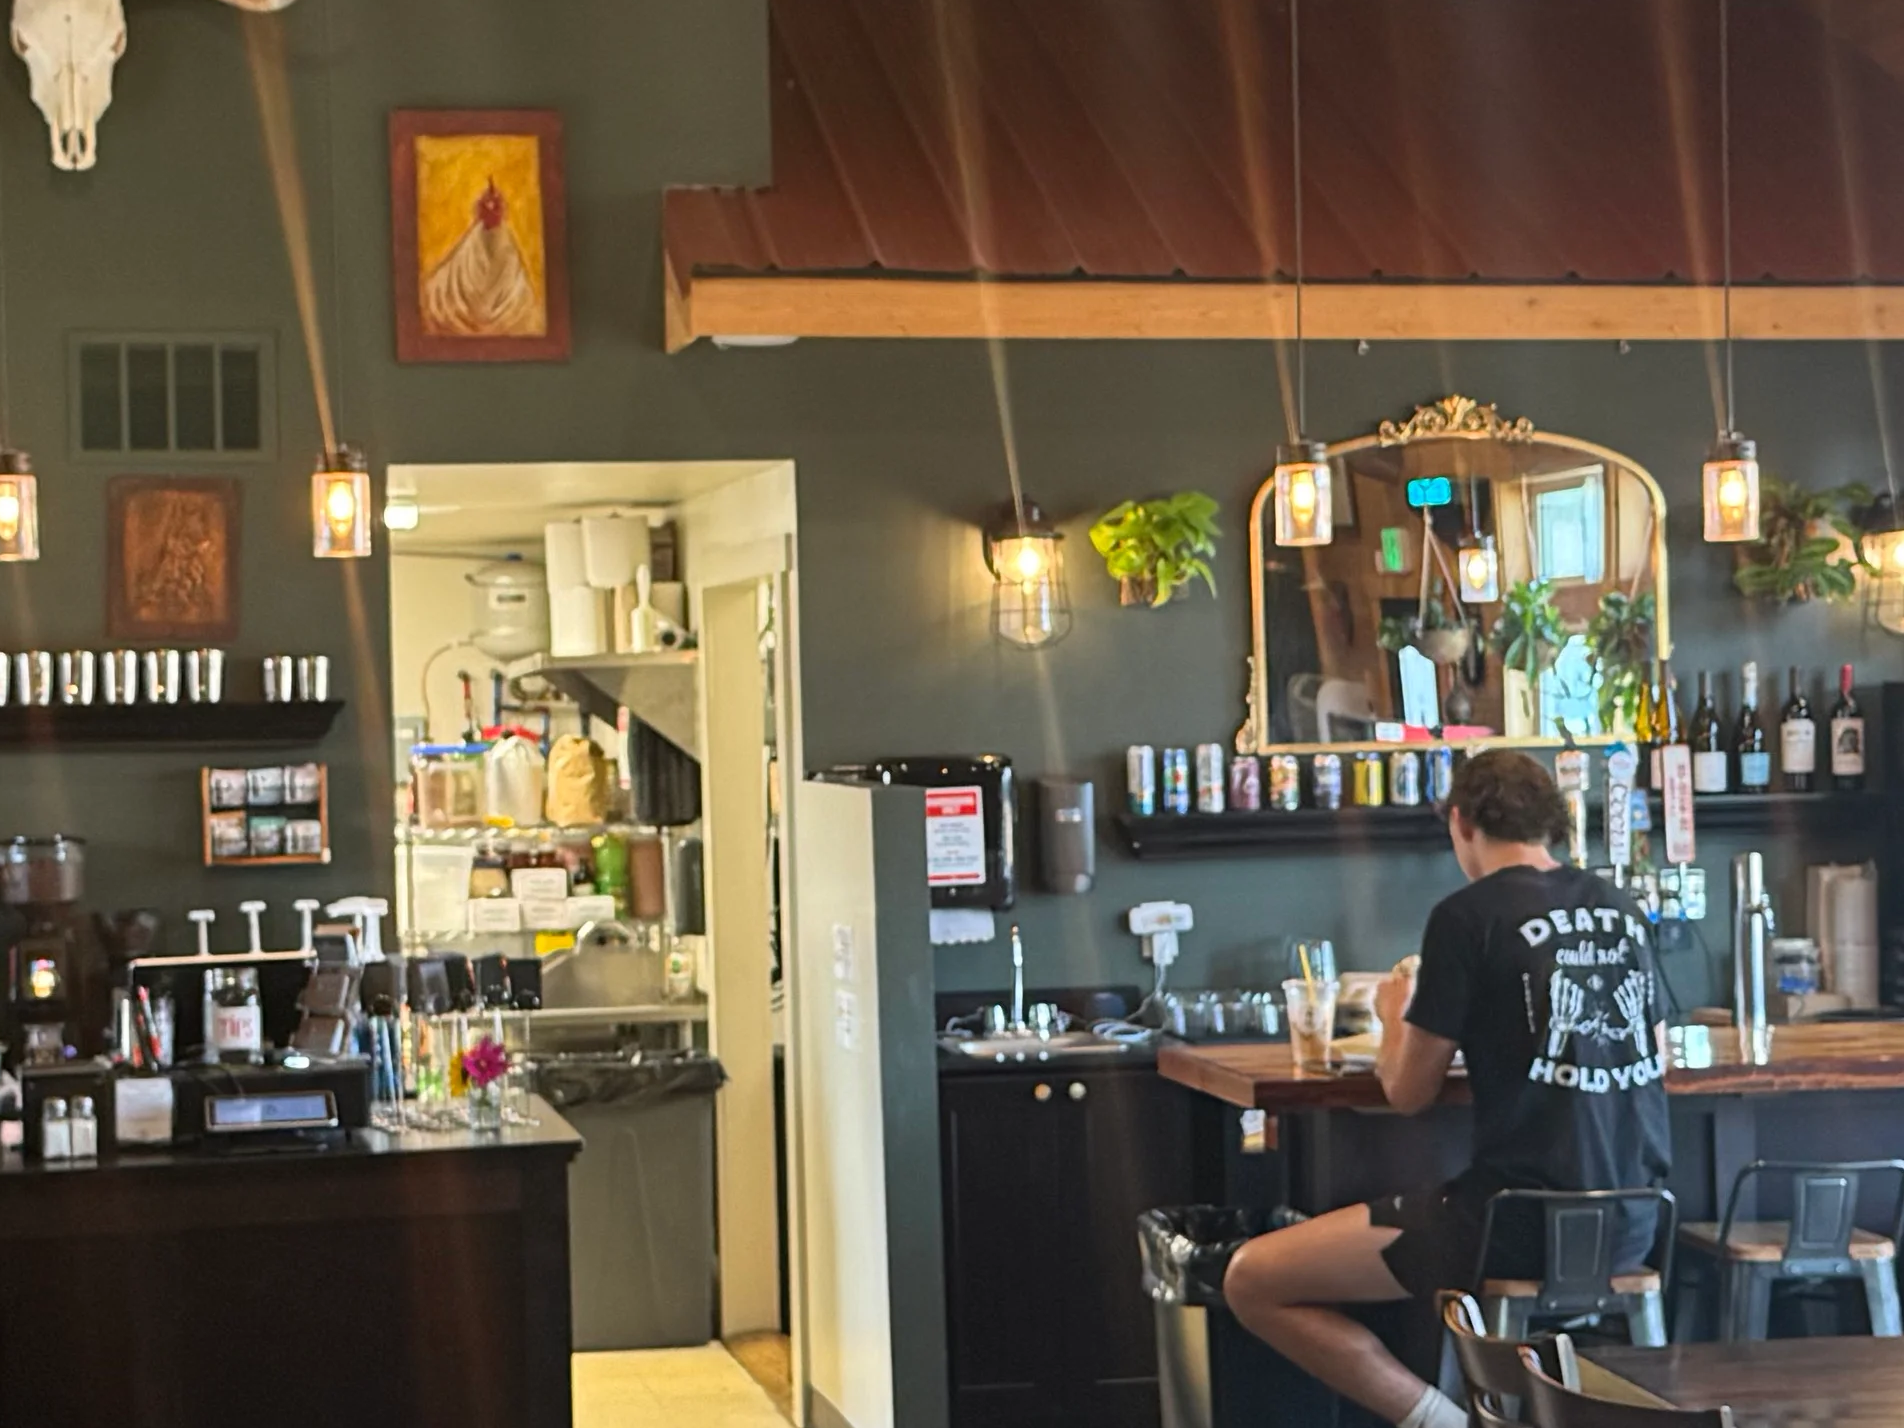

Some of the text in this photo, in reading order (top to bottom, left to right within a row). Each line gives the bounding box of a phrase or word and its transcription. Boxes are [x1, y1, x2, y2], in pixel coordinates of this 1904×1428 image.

[1518, 907, 1646, 949] DEATH
[1555, 937, 1631, 967] could not
[1527, 1053, 1667, 1094] HOLD YOU
